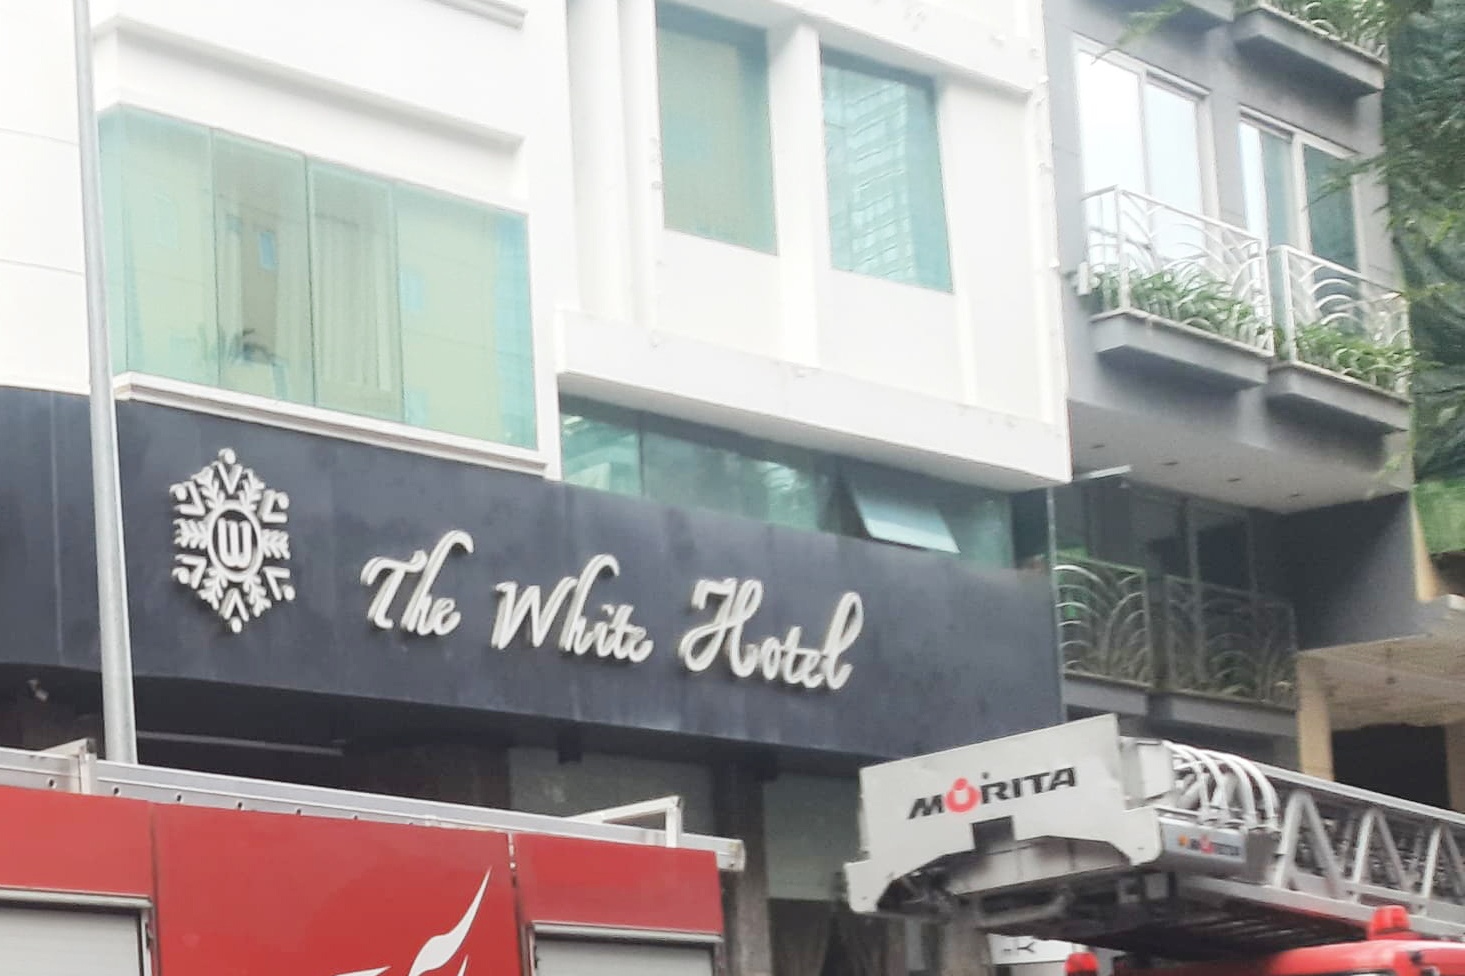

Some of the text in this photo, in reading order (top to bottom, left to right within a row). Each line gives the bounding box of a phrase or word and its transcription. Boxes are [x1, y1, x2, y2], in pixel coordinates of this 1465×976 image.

[360, 530, 864, 690] The White Hotel
[907, 766, 1078, 820] MORITA
